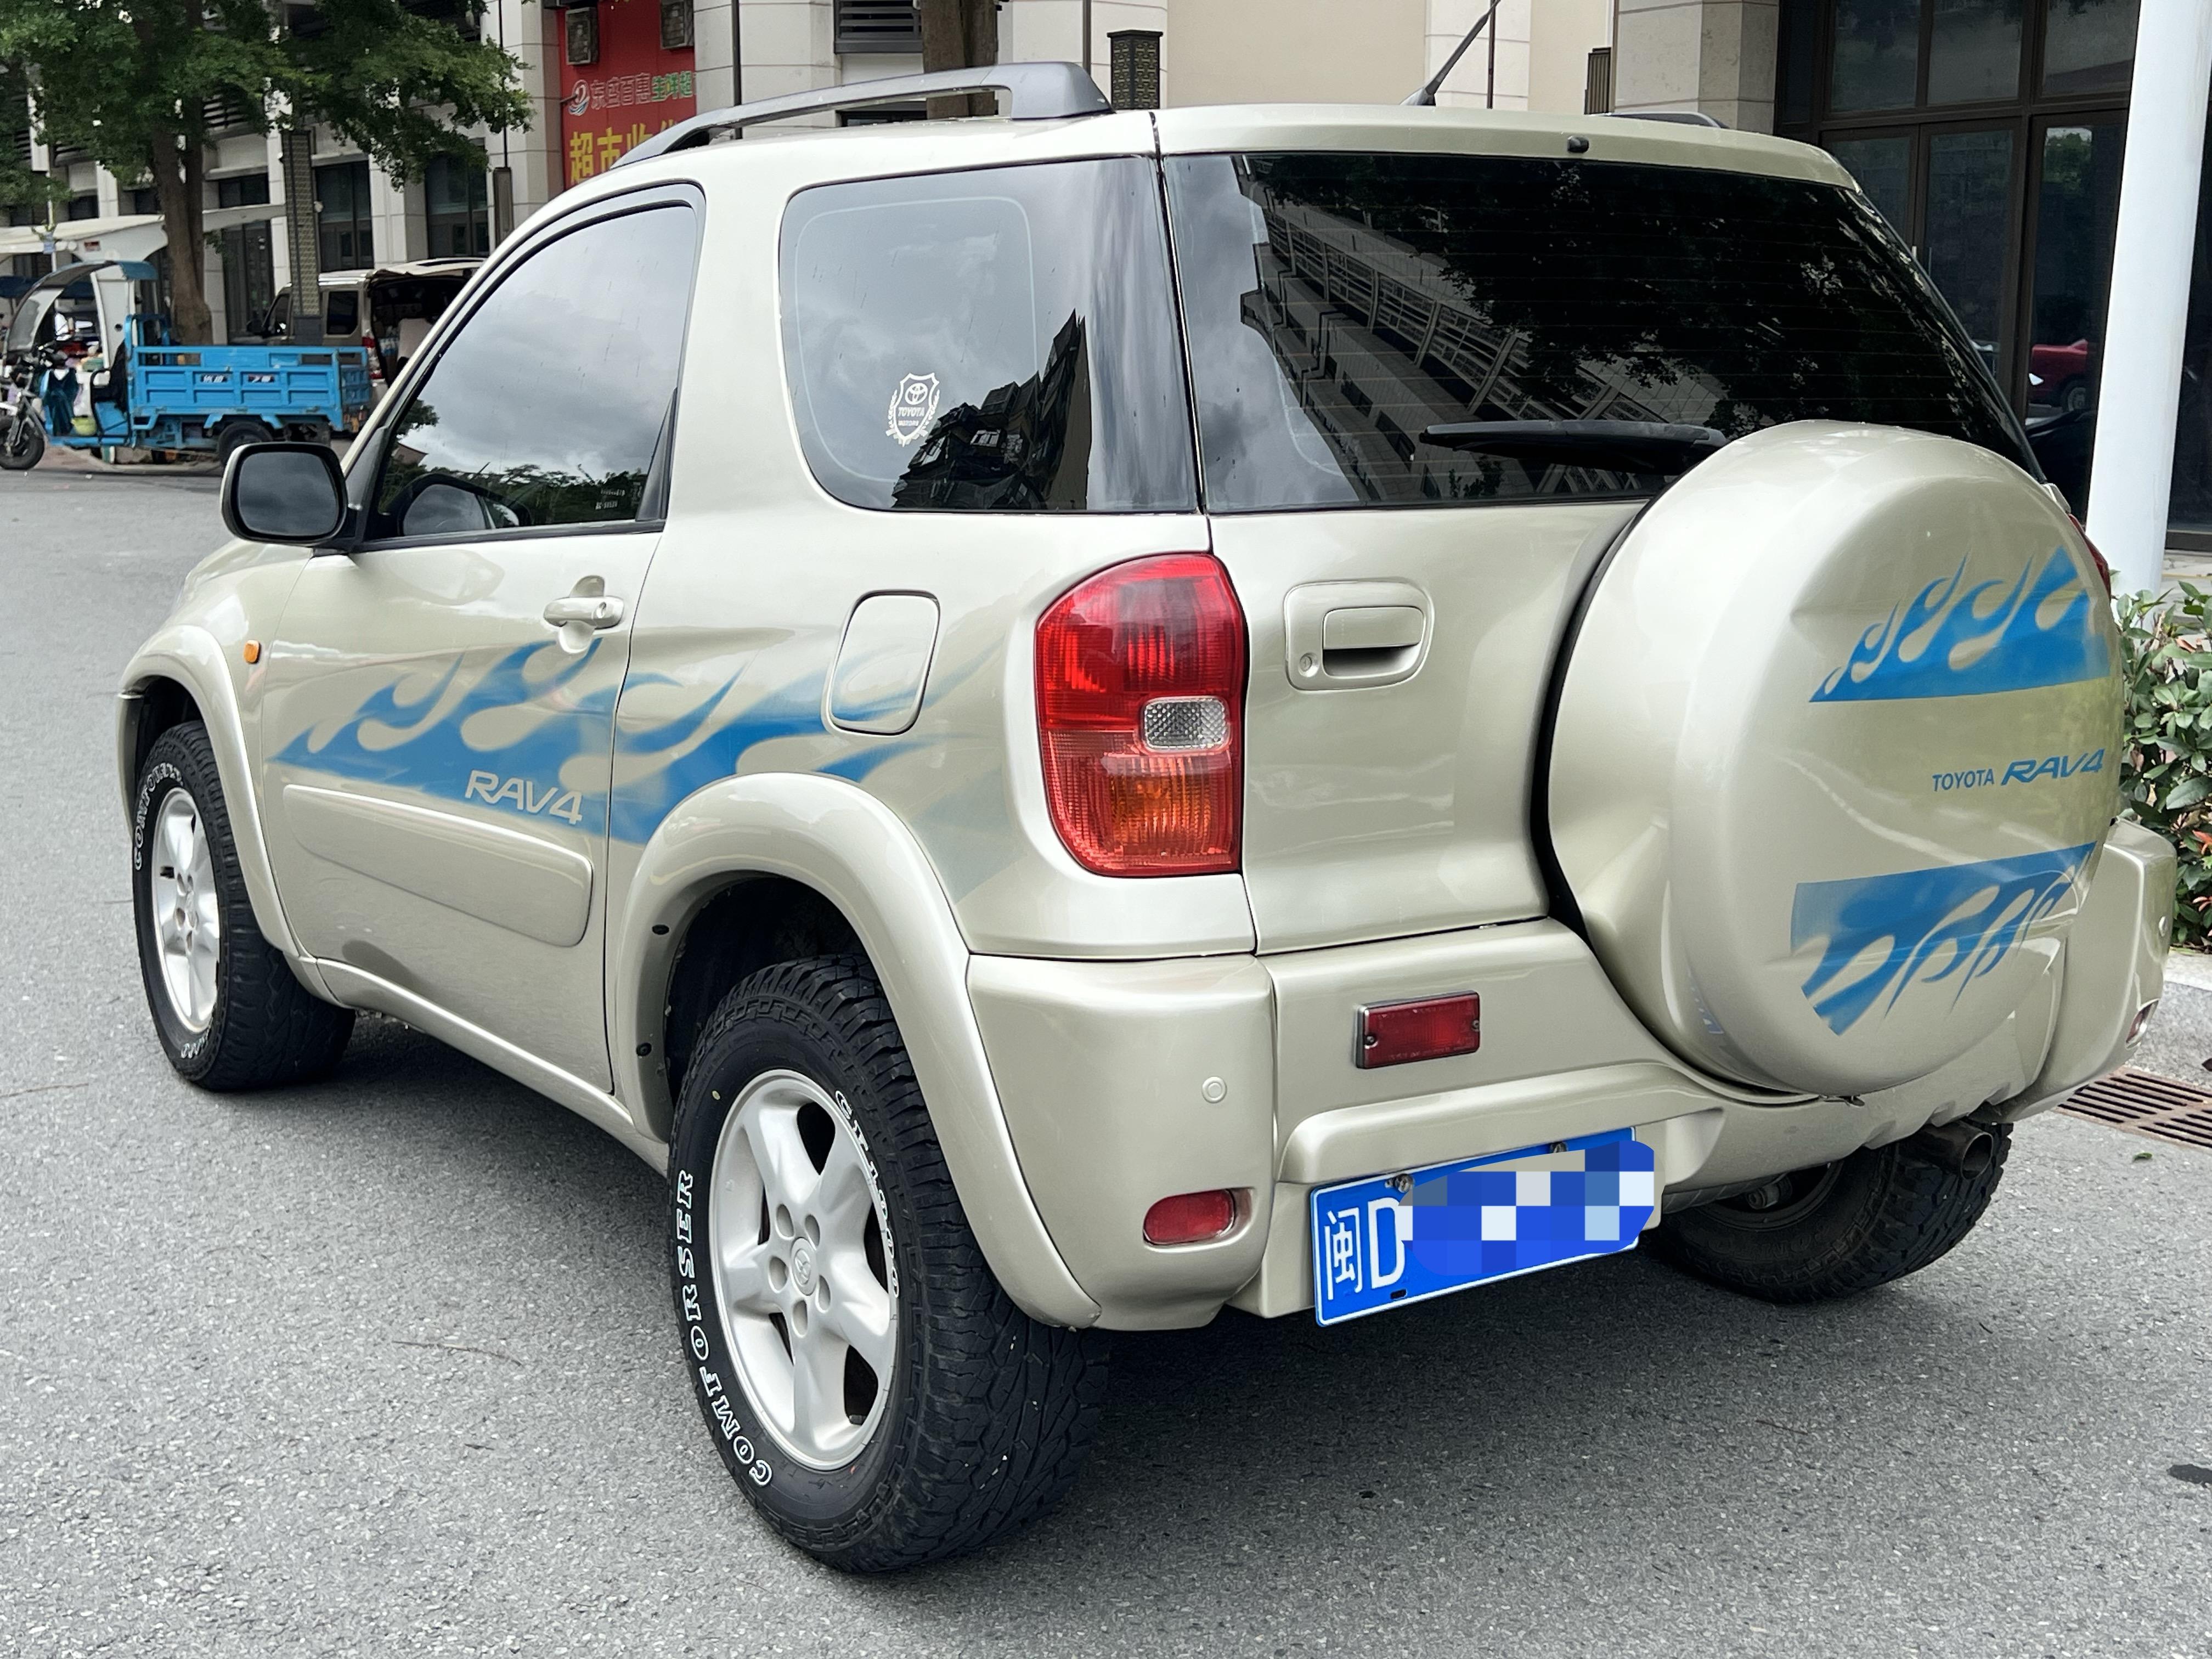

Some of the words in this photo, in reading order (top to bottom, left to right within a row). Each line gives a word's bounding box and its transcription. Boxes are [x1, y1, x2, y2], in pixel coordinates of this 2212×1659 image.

[570, 119, 674, 184] 超市
[898, 406, 925, 417] TOYOTA
[465, 769, 584, 825] RAV4
[1932, 769, 1994, 792] TOYOTA
[2000, 748, 2105, 786] RAV4
[676, 1169, 772, 1486] COMFORSER
